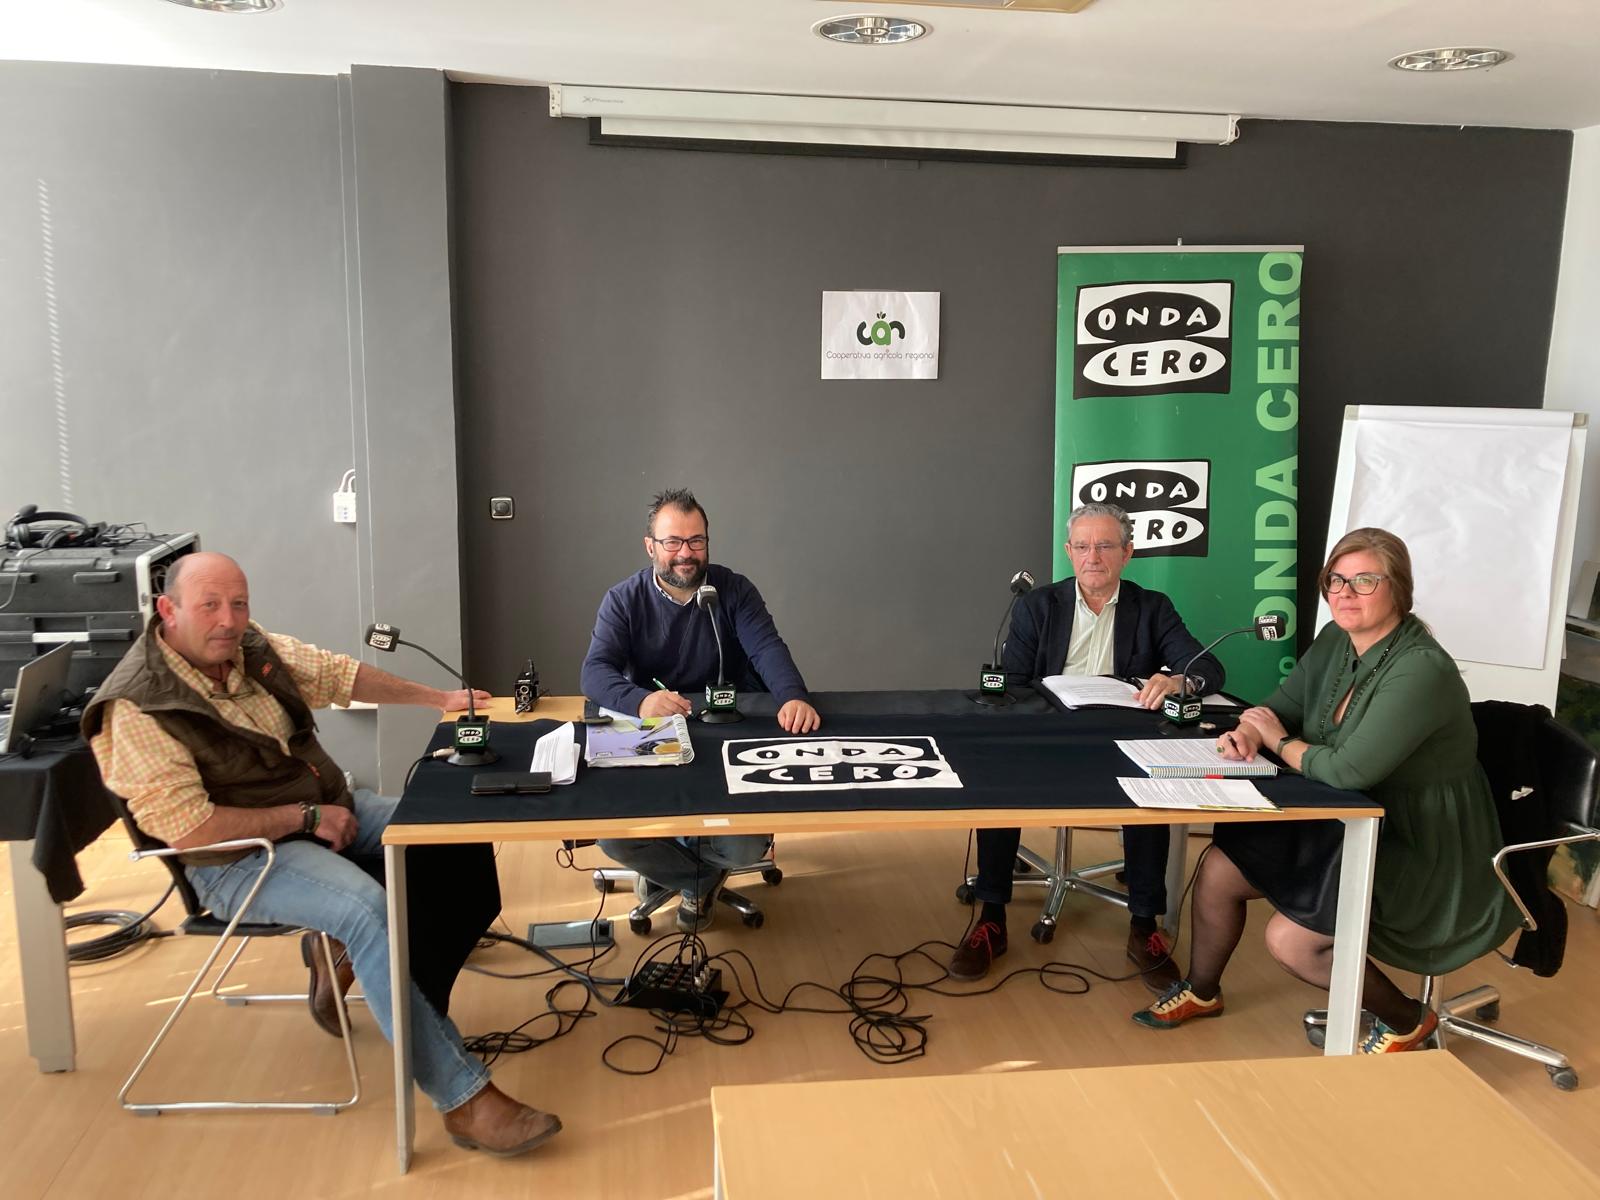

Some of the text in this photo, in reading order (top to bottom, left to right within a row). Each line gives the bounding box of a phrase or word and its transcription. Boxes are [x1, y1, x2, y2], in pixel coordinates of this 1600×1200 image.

[1097, 306, 1208, 331] ONDA
[826, 350, 871, 360] Cooperativa
[905, 351, 935, 361] regional
[1102, 349, 1208, 377] CERO
[1253, 251, 1302, 641] ONDA CERO
[1090, 481, 1189, 502] ONDA
[1130, 518, 1188, 541] RO
[755, 747, 906, 761] ONDA
[768, 764, 920, 781] CERO
